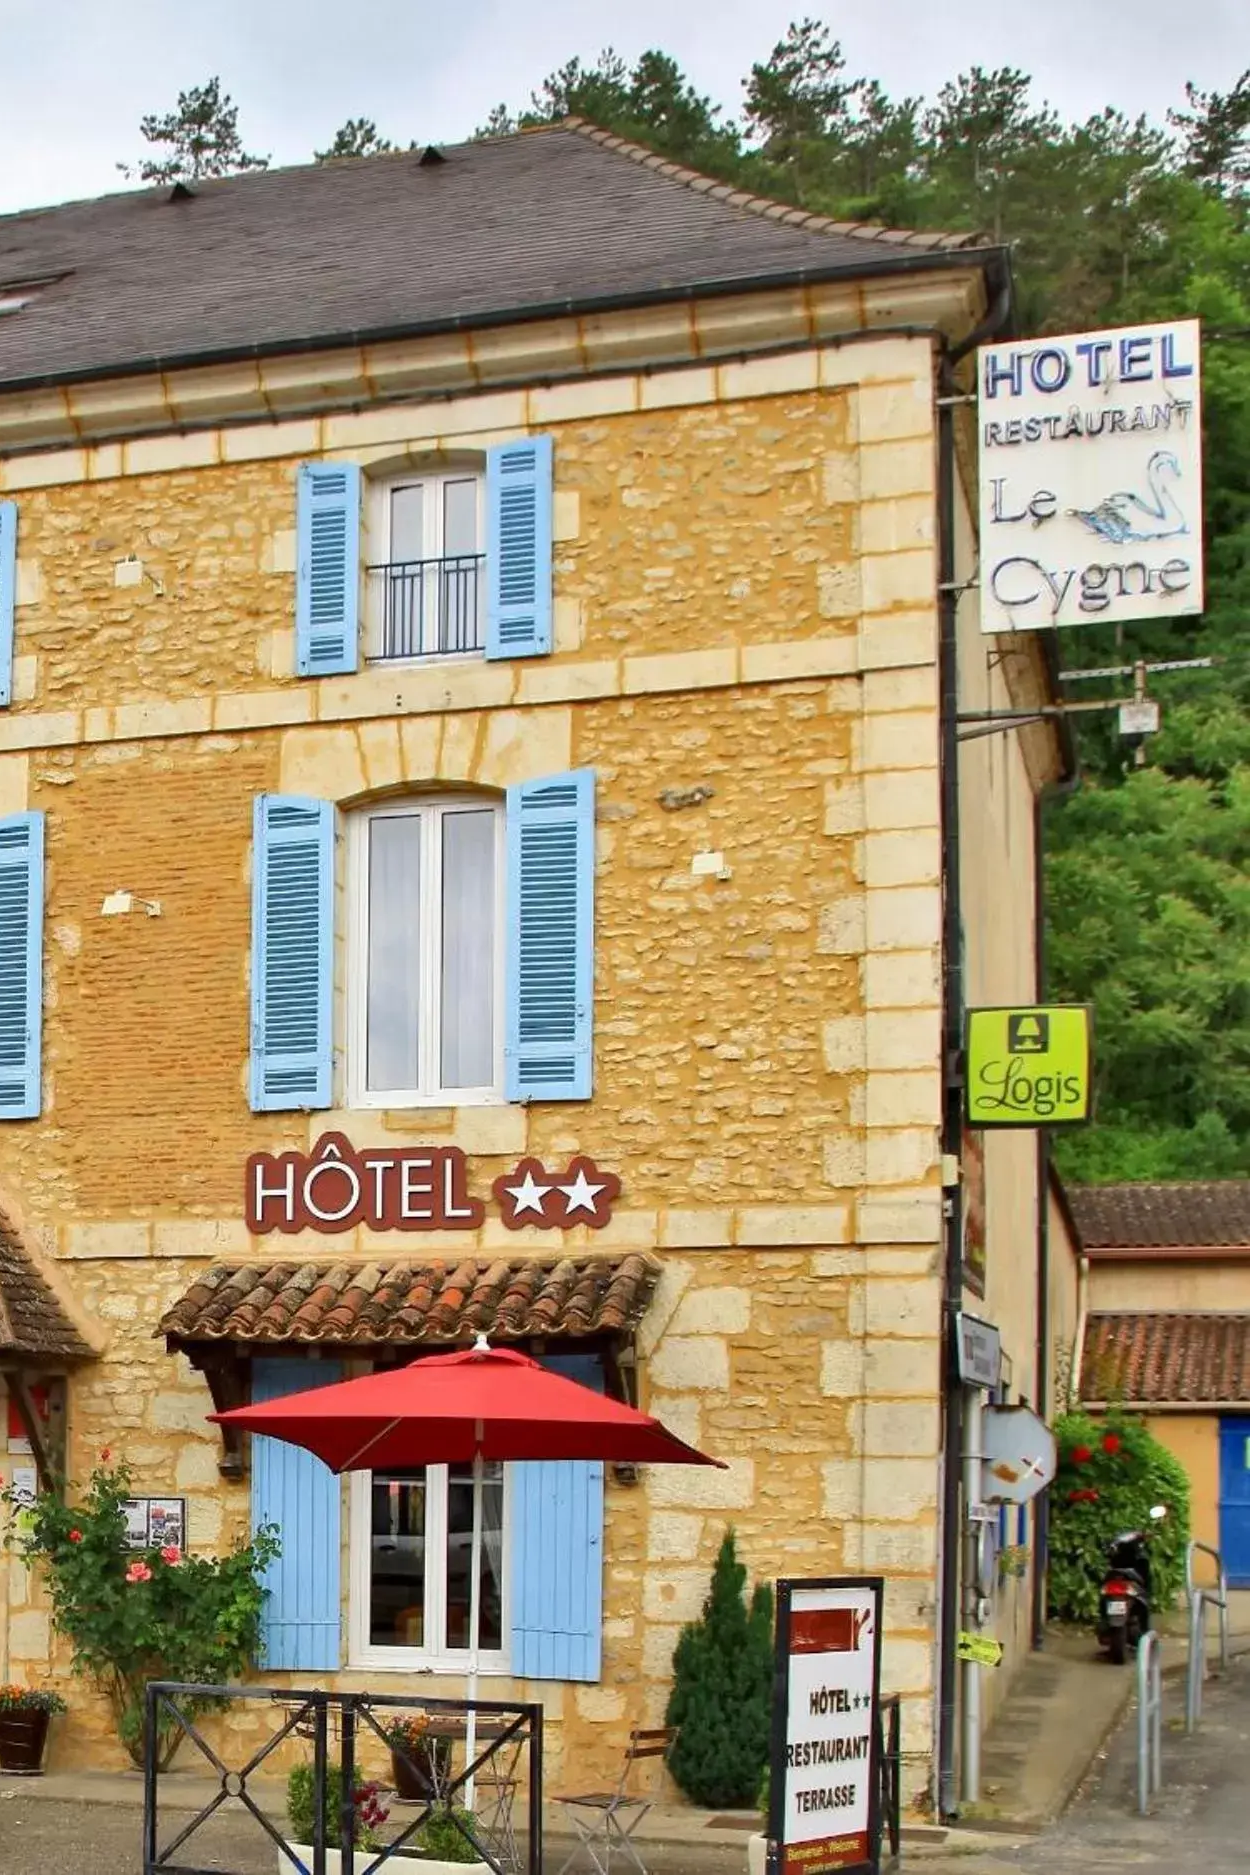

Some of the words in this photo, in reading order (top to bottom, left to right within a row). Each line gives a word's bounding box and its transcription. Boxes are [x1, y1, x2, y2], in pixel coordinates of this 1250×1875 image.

[984, 333, 1193, 399] HOTEL
[984, 401, 1192, 447] RESTAURANT
[990, 478, 1057, 524] Le
[991, 557, 1190, 614] Cygne
[975, 1057, 1080, 1115] Logis
[254, 1143, 472, 1221] HÔTEL
[809, 1687, 851, 1715] HÔTEL
[786, 1735, 869, 1768] RESTAURANT
[795, 1784, 857, 1814] TERRASSE
